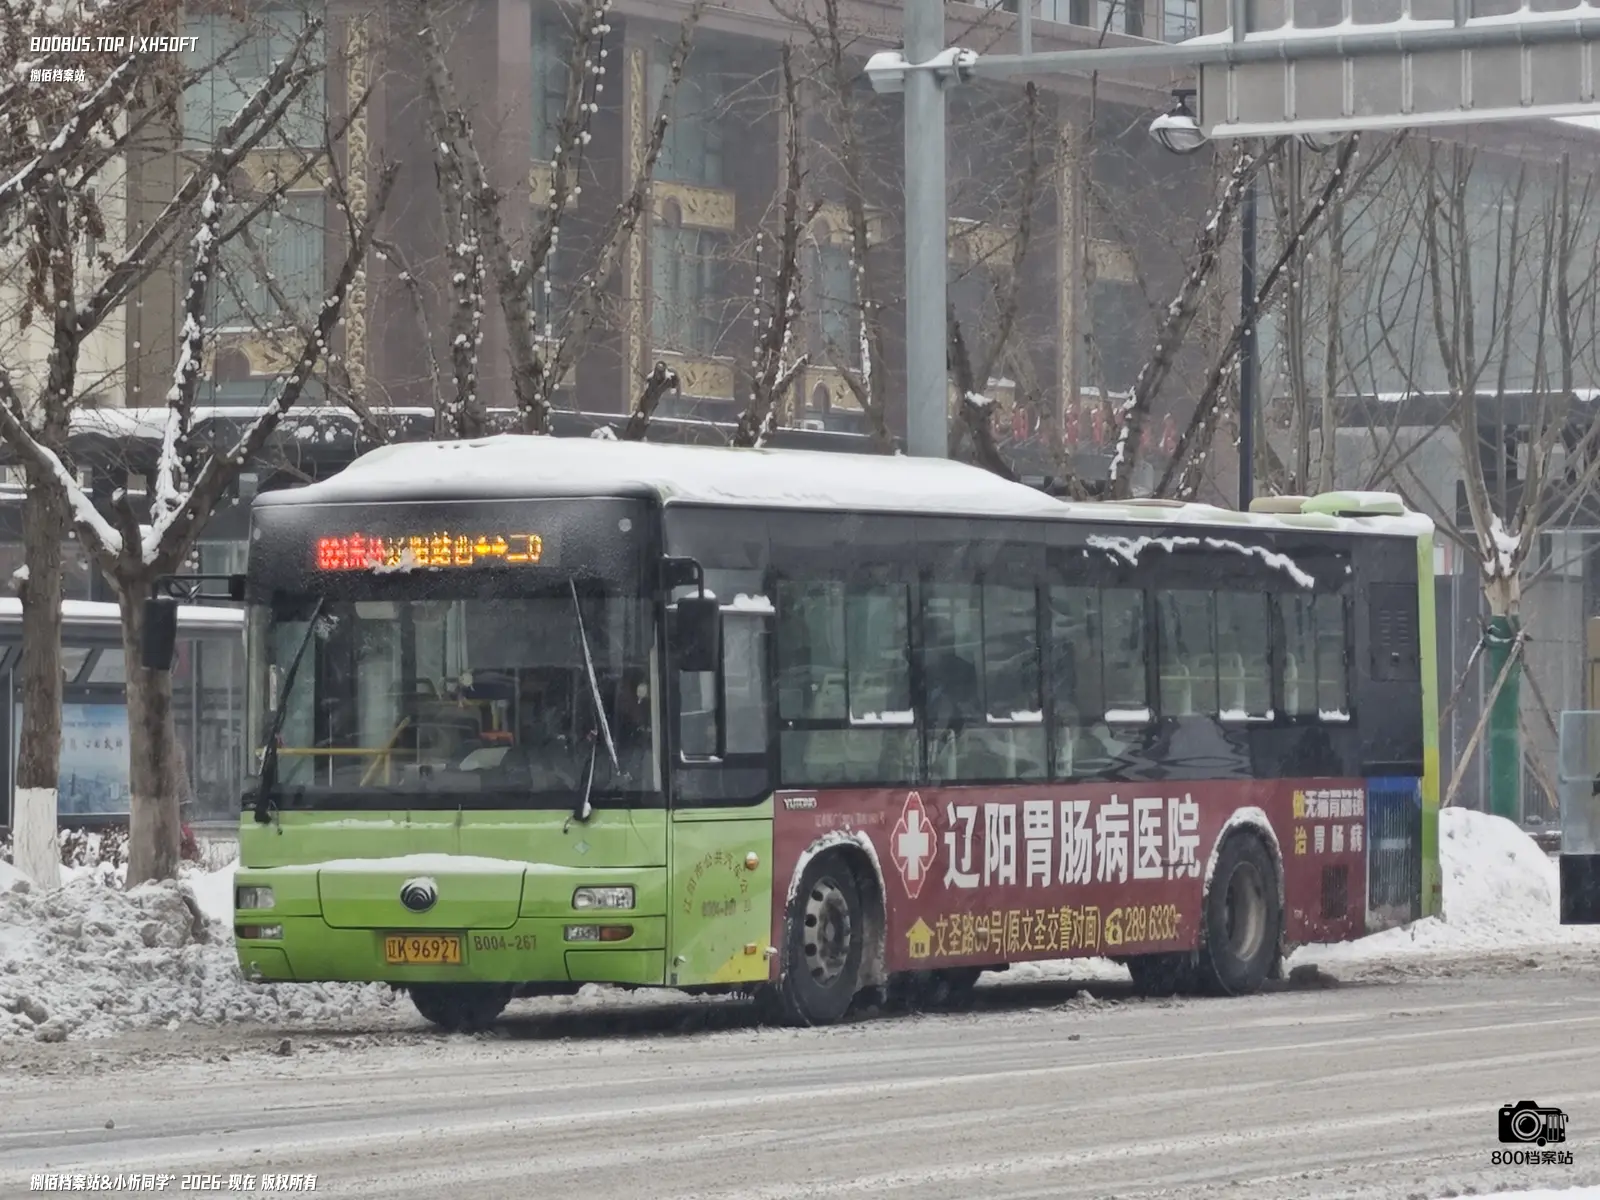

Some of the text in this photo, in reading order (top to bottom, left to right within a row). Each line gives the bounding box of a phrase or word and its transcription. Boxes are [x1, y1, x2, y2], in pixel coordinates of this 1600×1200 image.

[943, 792, 1201, 890] 辽阳胃肠病医院
[473, 934, 537, 951] B004-267
[1124, 905, 1147, 943] 289
